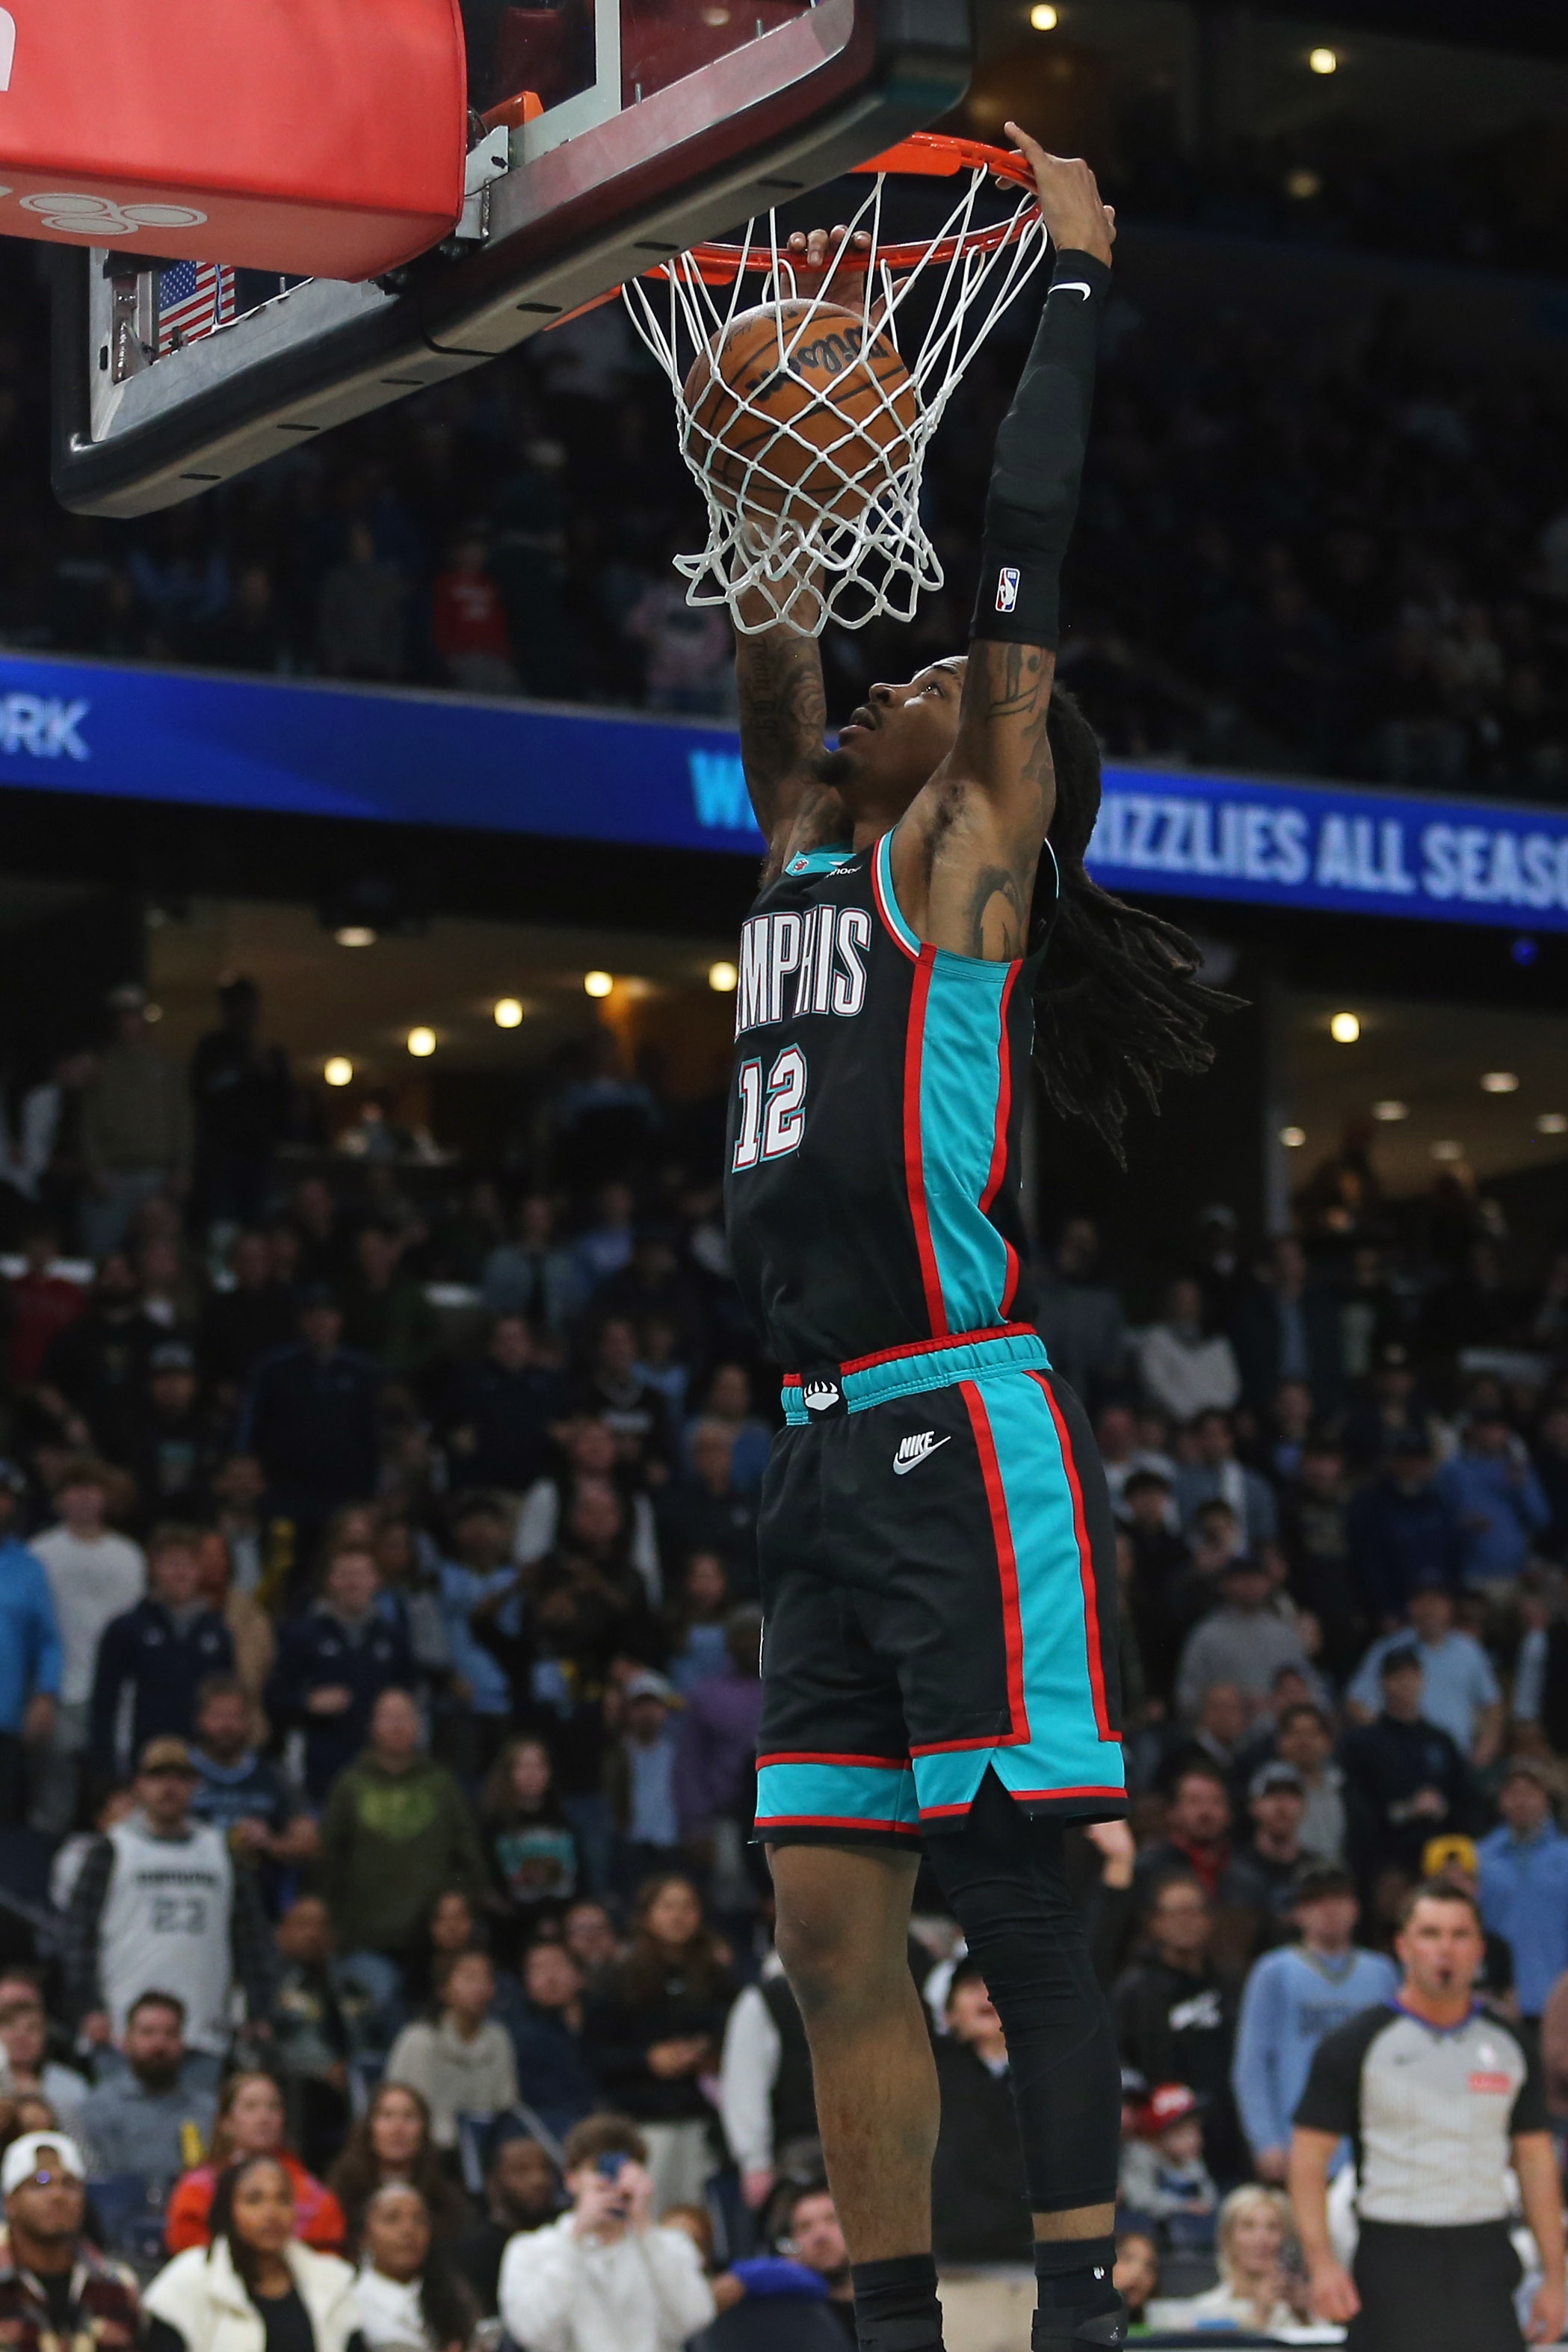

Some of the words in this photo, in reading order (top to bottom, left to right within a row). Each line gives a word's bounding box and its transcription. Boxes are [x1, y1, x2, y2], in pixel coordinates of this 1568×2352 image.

[0, 693, 90, 762] RK
[688, 749, 760, 832] W
[1315, 813, 1416, 895] ALL
[735, 904, 872, 1043] MPHIS
[732, 1043, 807, 1173] 12
[898, 1430, 935, 1460] NIKE
